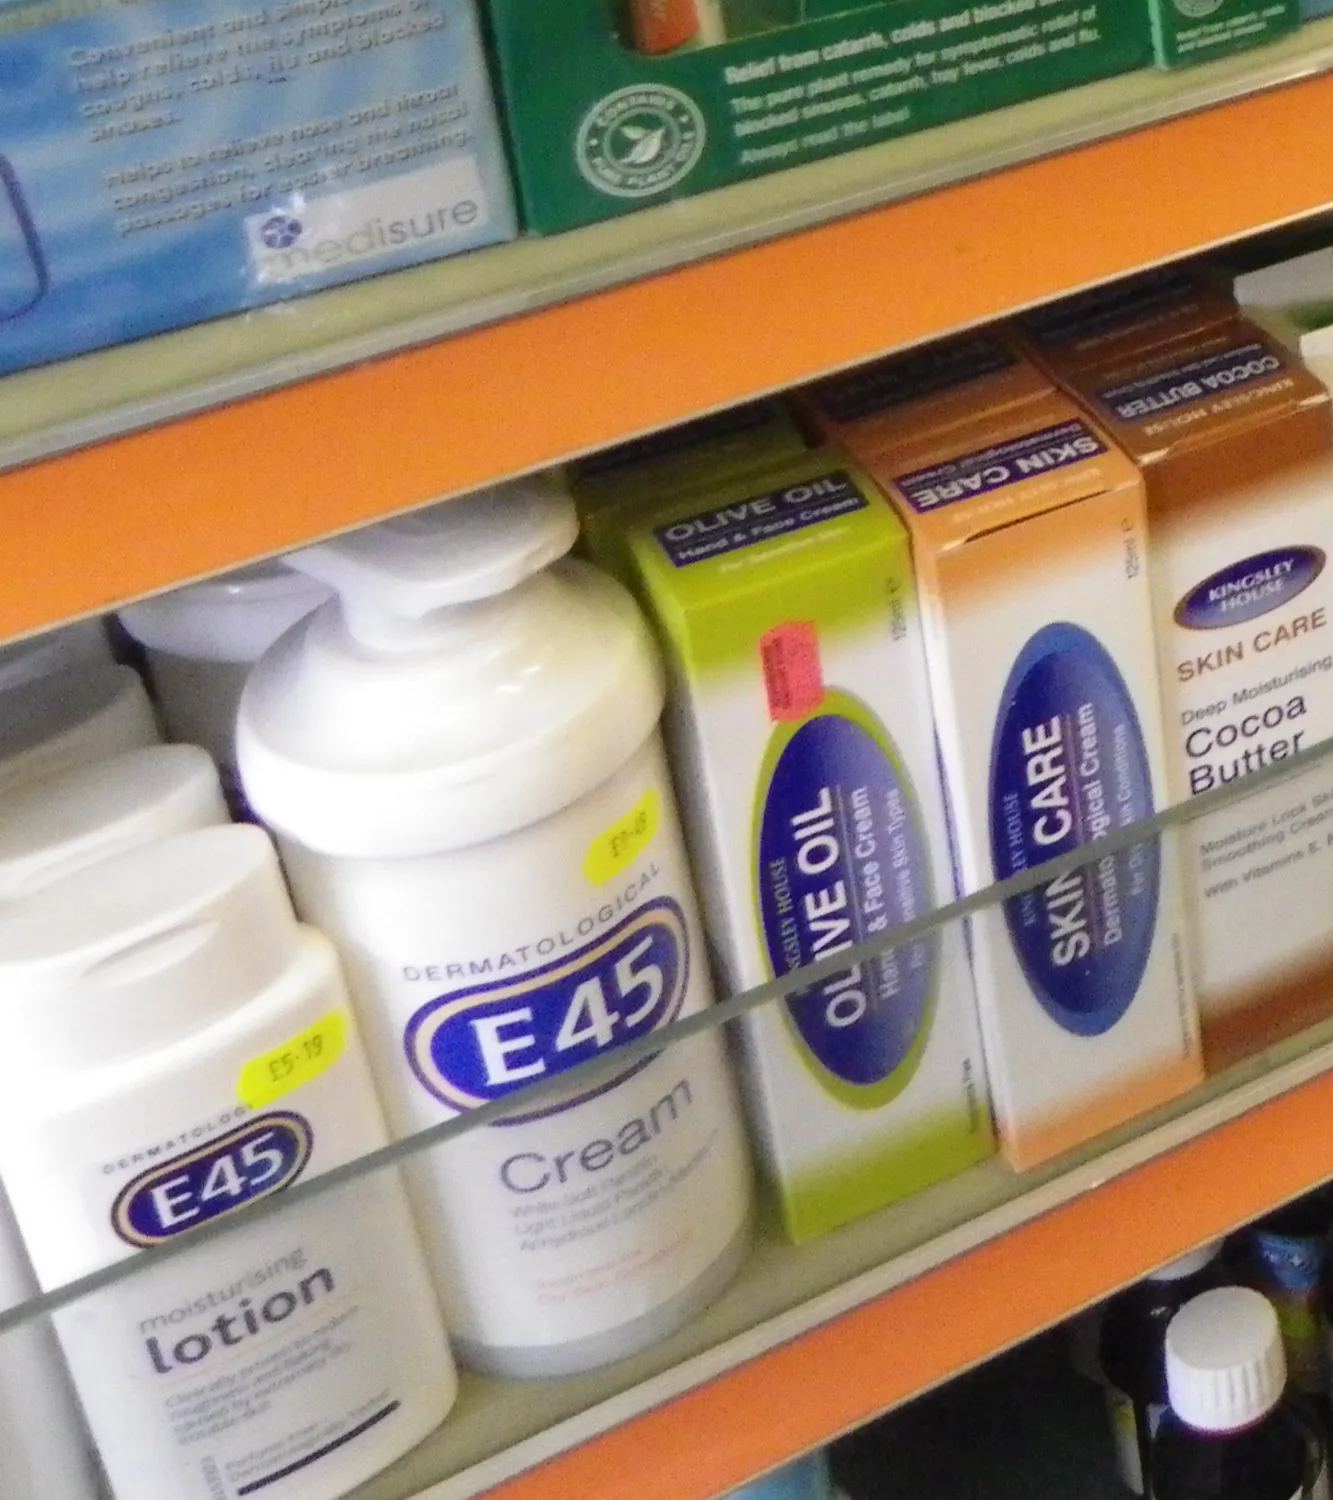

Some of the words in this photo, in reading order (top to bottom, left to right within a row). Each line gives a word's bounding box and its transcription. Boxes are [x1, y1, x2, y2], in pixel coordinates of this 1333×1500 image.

[725, 58, 776, 86] Relief
[779, 48, 820, 71] from
[890, 19, 937, 45] colds
[939, 10, 971, 32] and
[264, 196, 480, 271] medisure
[1114, 380, 1202, 422] BUTTER
[1203, 354, 1282, 392] COCOA
[914, 467, 1016, 510] CARE
[1022, 435, 1102, 475] SKIN
[663, 497, 780, 544] OLIVE
[782, 475, 848, 504] OIL
[1208, 558, 1295, 602] KINGSLEY
[1221, 579, 1285, 614] HOUSE
[1176, 641, 1244, 683] SKIN
[1252, 607, 1328, 653] CARE
[1181, 700, 1228, 726] Deep
[1232, 654, 1333, 705] Moisturising
[1185, 694, 1308, 760] Cocoa
[1078, 702, 1100, 776] Cream
[1189, 727, 1306, 796] Butter
[1021, 715, 1072, 846] CARE
[791, 787, 841, 876] OIL
[852, 785, 878, 855] Cream
[861, 859, 887, 914] Face
[1242, 851, 1305, 883] Vitamins
[402, 861, 661, 983] DERMATOLOGICAL
[1045, 865, 1090, 967] SKIN
[805, 879, 867, 1029] OLIVE
[470, 935, 666, 1089] E45
[499, 1077, 694, 1196] Cream
[150, 1132, 286, 1229] E45
[139, 1247, 308, 1334] moisturising
[145, 1267, 336, 1375] lotion
